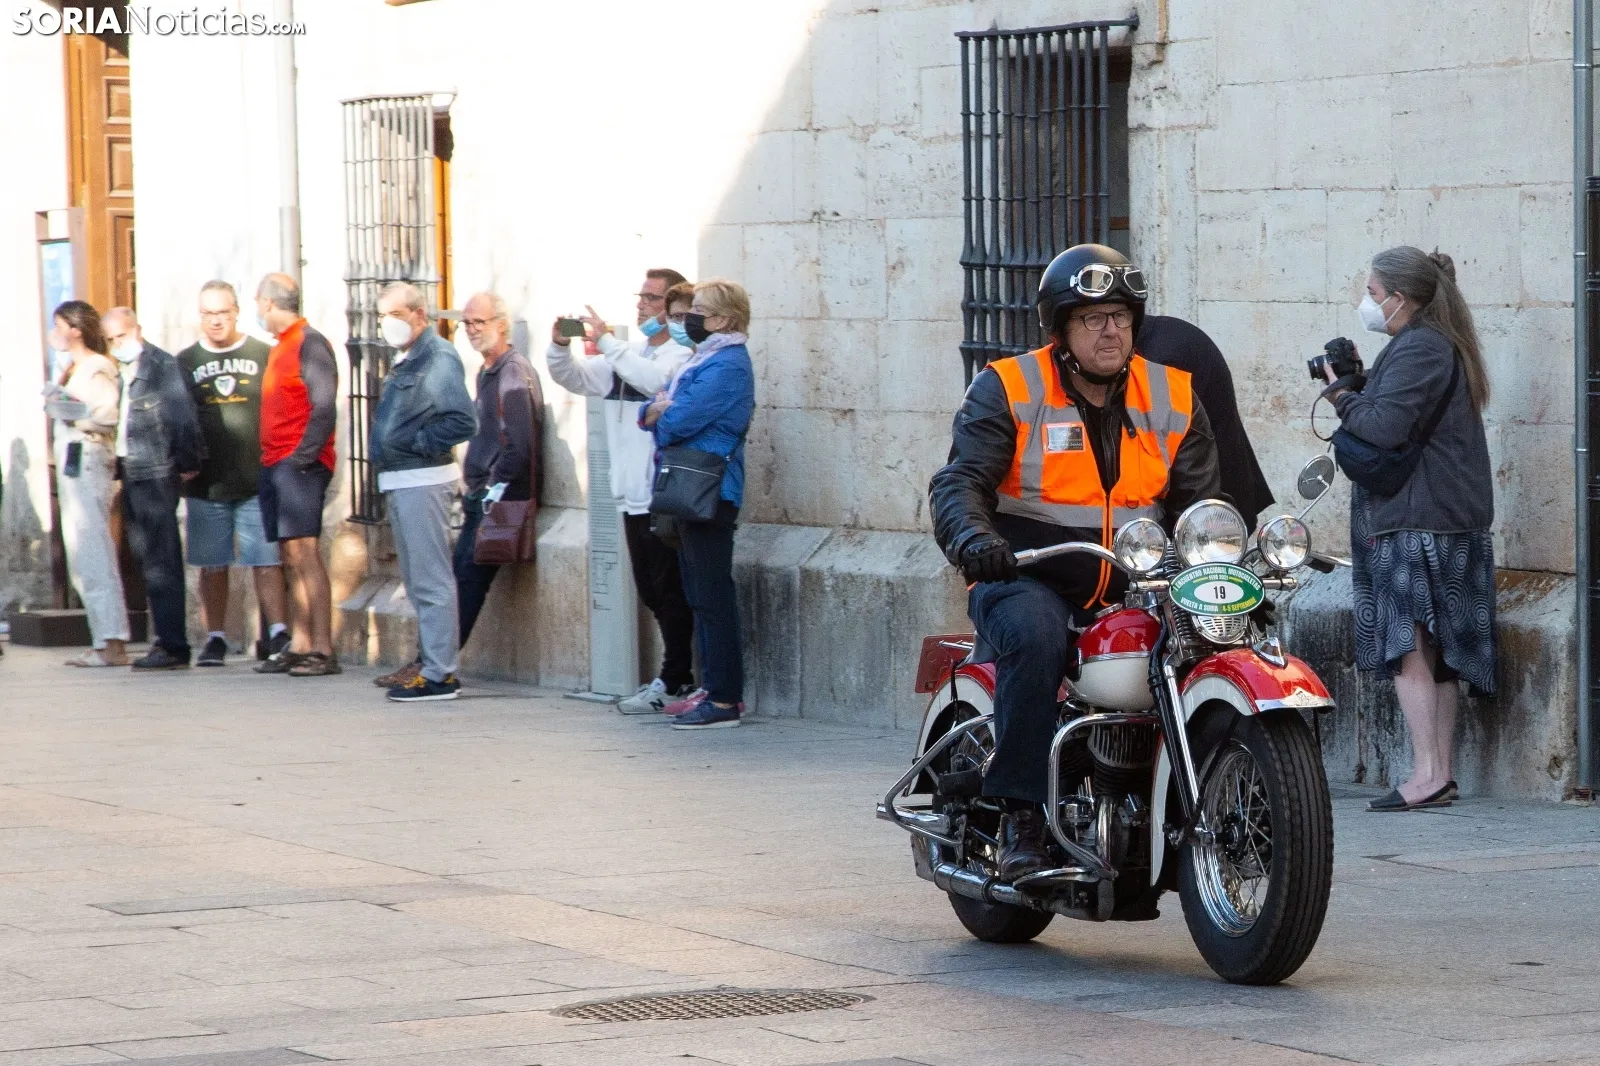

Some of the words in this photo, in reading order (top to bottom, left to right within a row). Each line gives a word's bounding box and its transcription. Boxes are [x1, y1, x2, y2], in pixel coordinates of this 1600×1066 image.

[192, 358, 259, 384] IRELAND
[1176, 569, 1202, 590] ENCUENTRO
[1202, 566, 1228, 575] NACIONAL
[1227, 567, 1261, 591] MOTOCICLETAS
[1213, 585, 1226, 600] 19
[1180, 596, 1198, 610] VUELTA
[1198, 603, 1203, 611] A
[1203, 604, 1219, 612] SORIA
[1222, 603, 1232, 612] 4-5
[1231, 596, 1257, 612] SEPTIEMBRE
